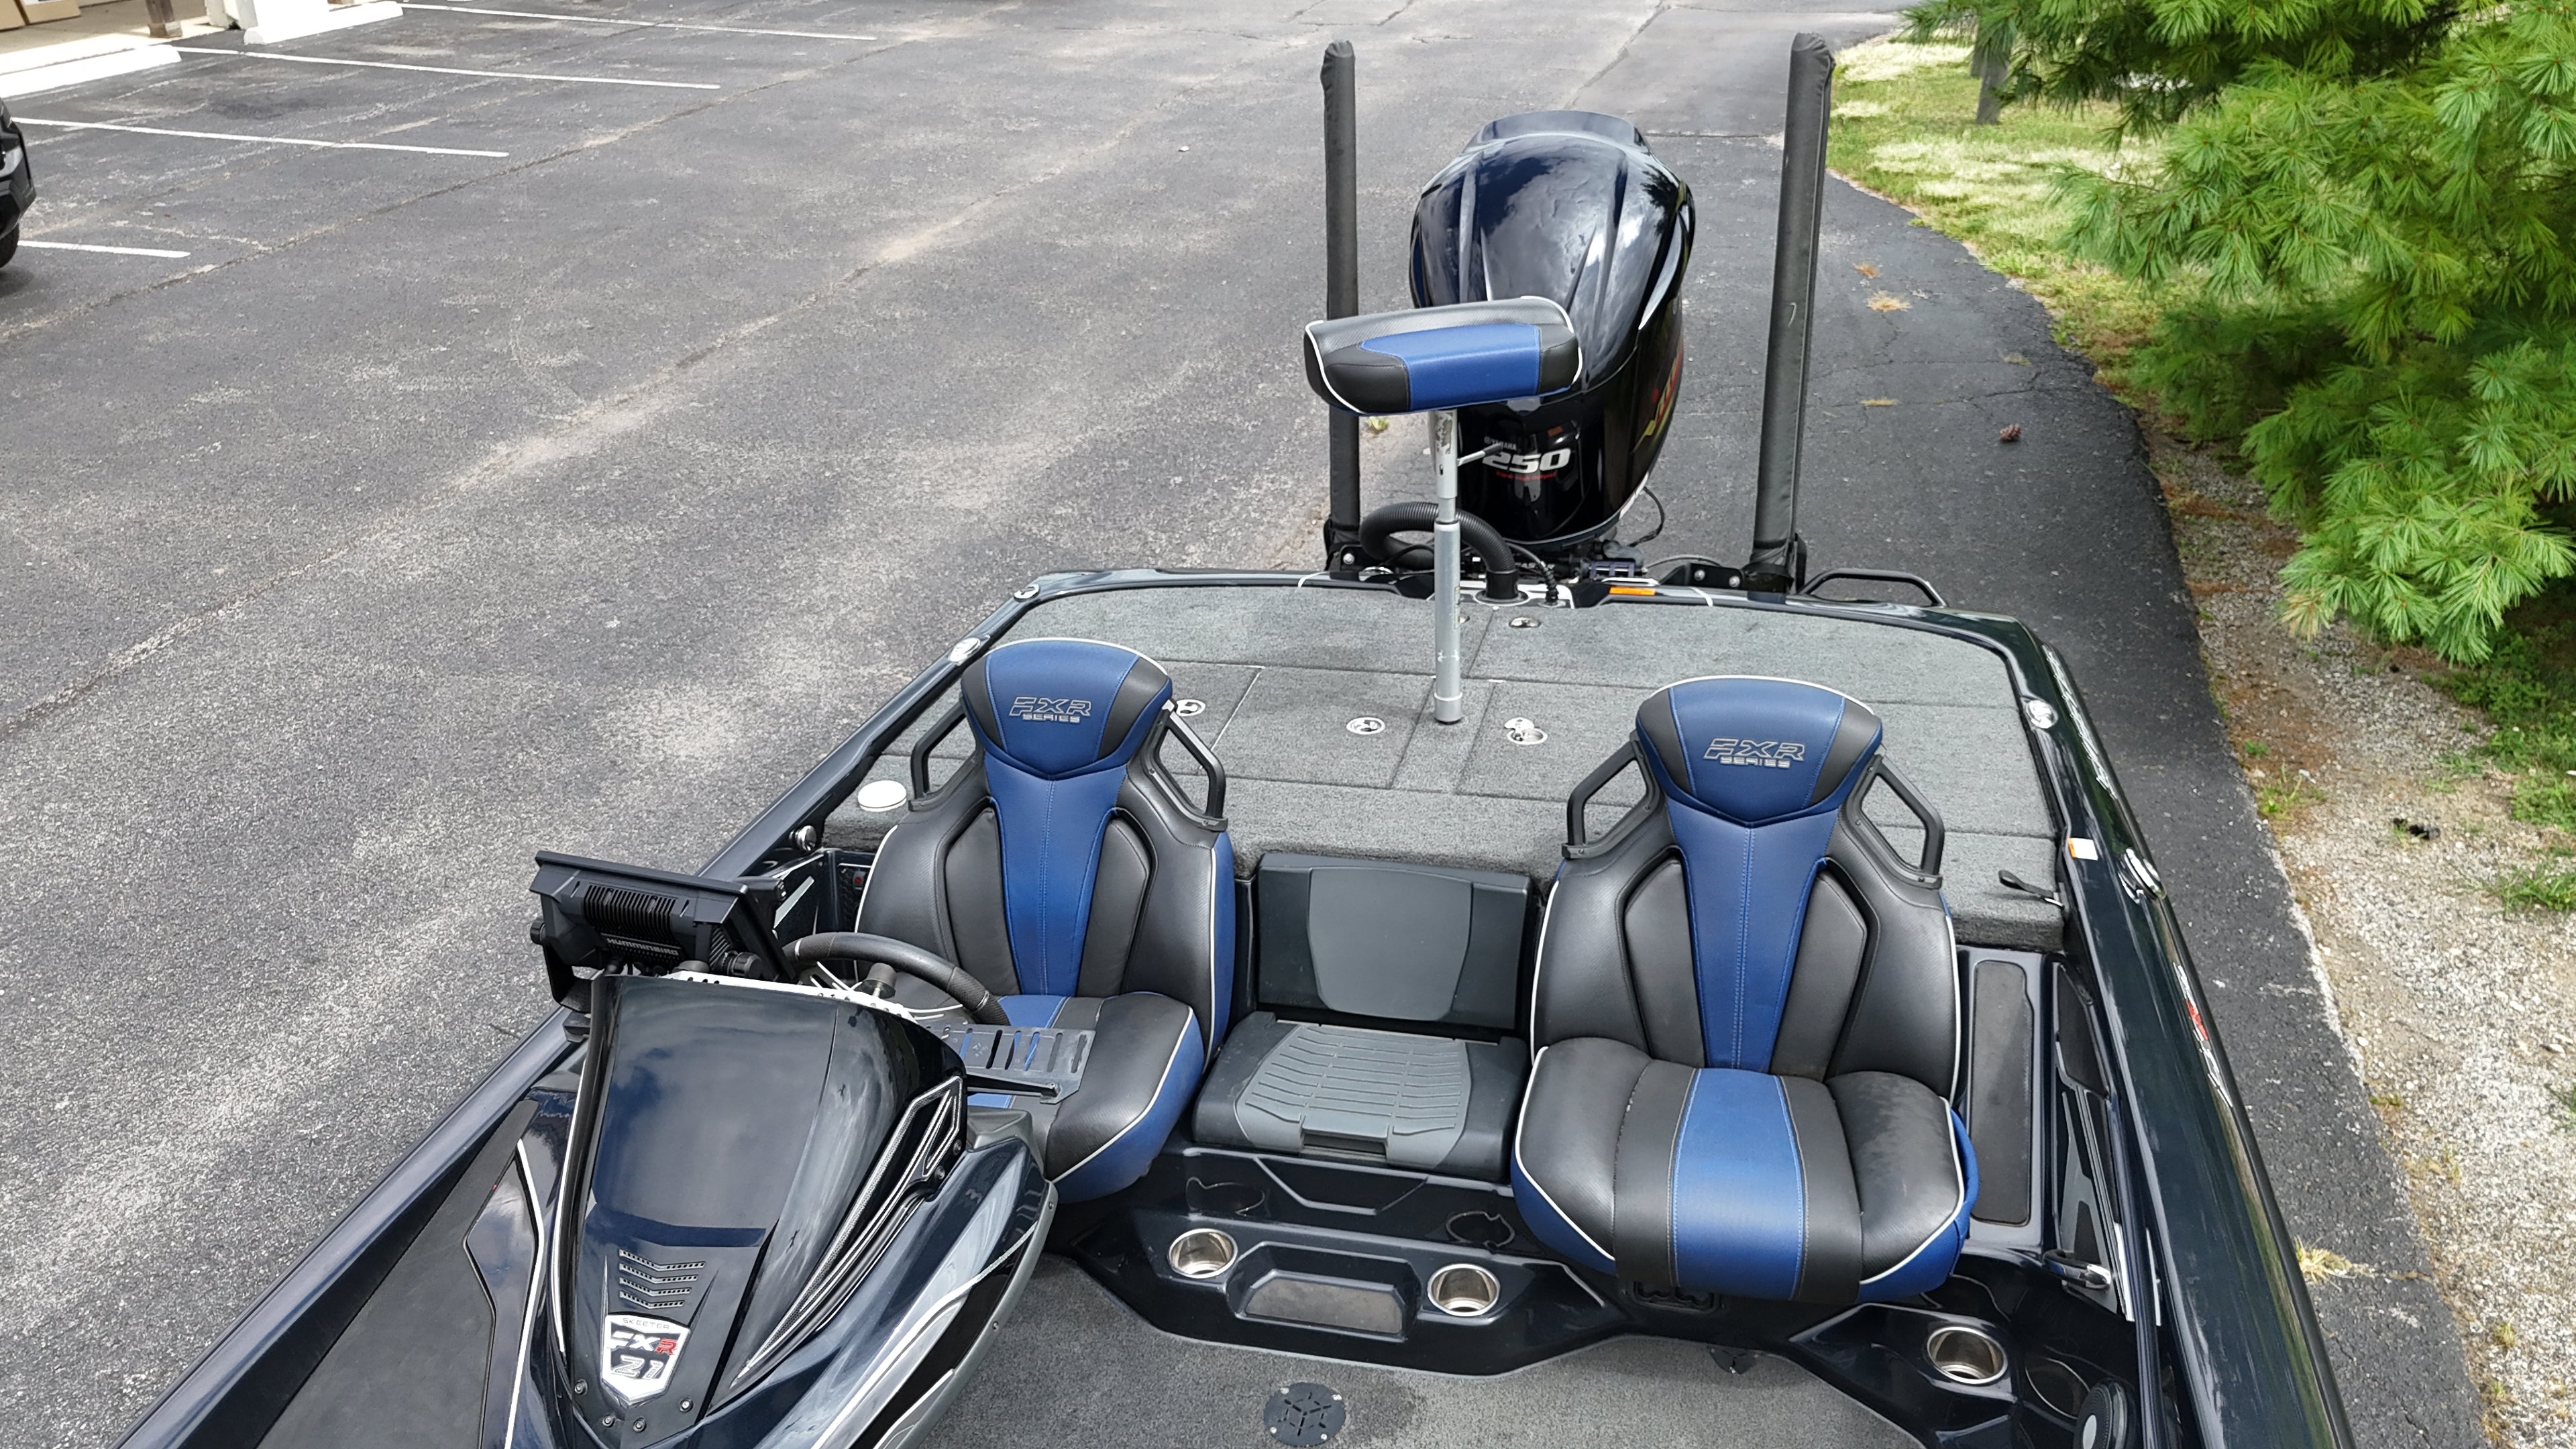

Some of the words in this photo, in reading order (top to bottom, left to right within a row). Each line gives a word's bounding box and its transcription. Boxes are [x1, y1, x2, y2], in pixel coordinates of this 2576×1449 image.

[1482, 447, 1571, 474] 250
[1009, 696, 1091, 716] FXR
[1022, 713, 1081, 724] SERIES
[1703, 738, 1805, 761] FXR
[1719, 756, 1790, 769] SERIES
[606, 938, 679, 956] HUMMINBIRD
[623, 1318, 669, 1330] SKEETER
[607, 1331, 678, 1356] FXR
[611, 1354, 664, 1381] 21
